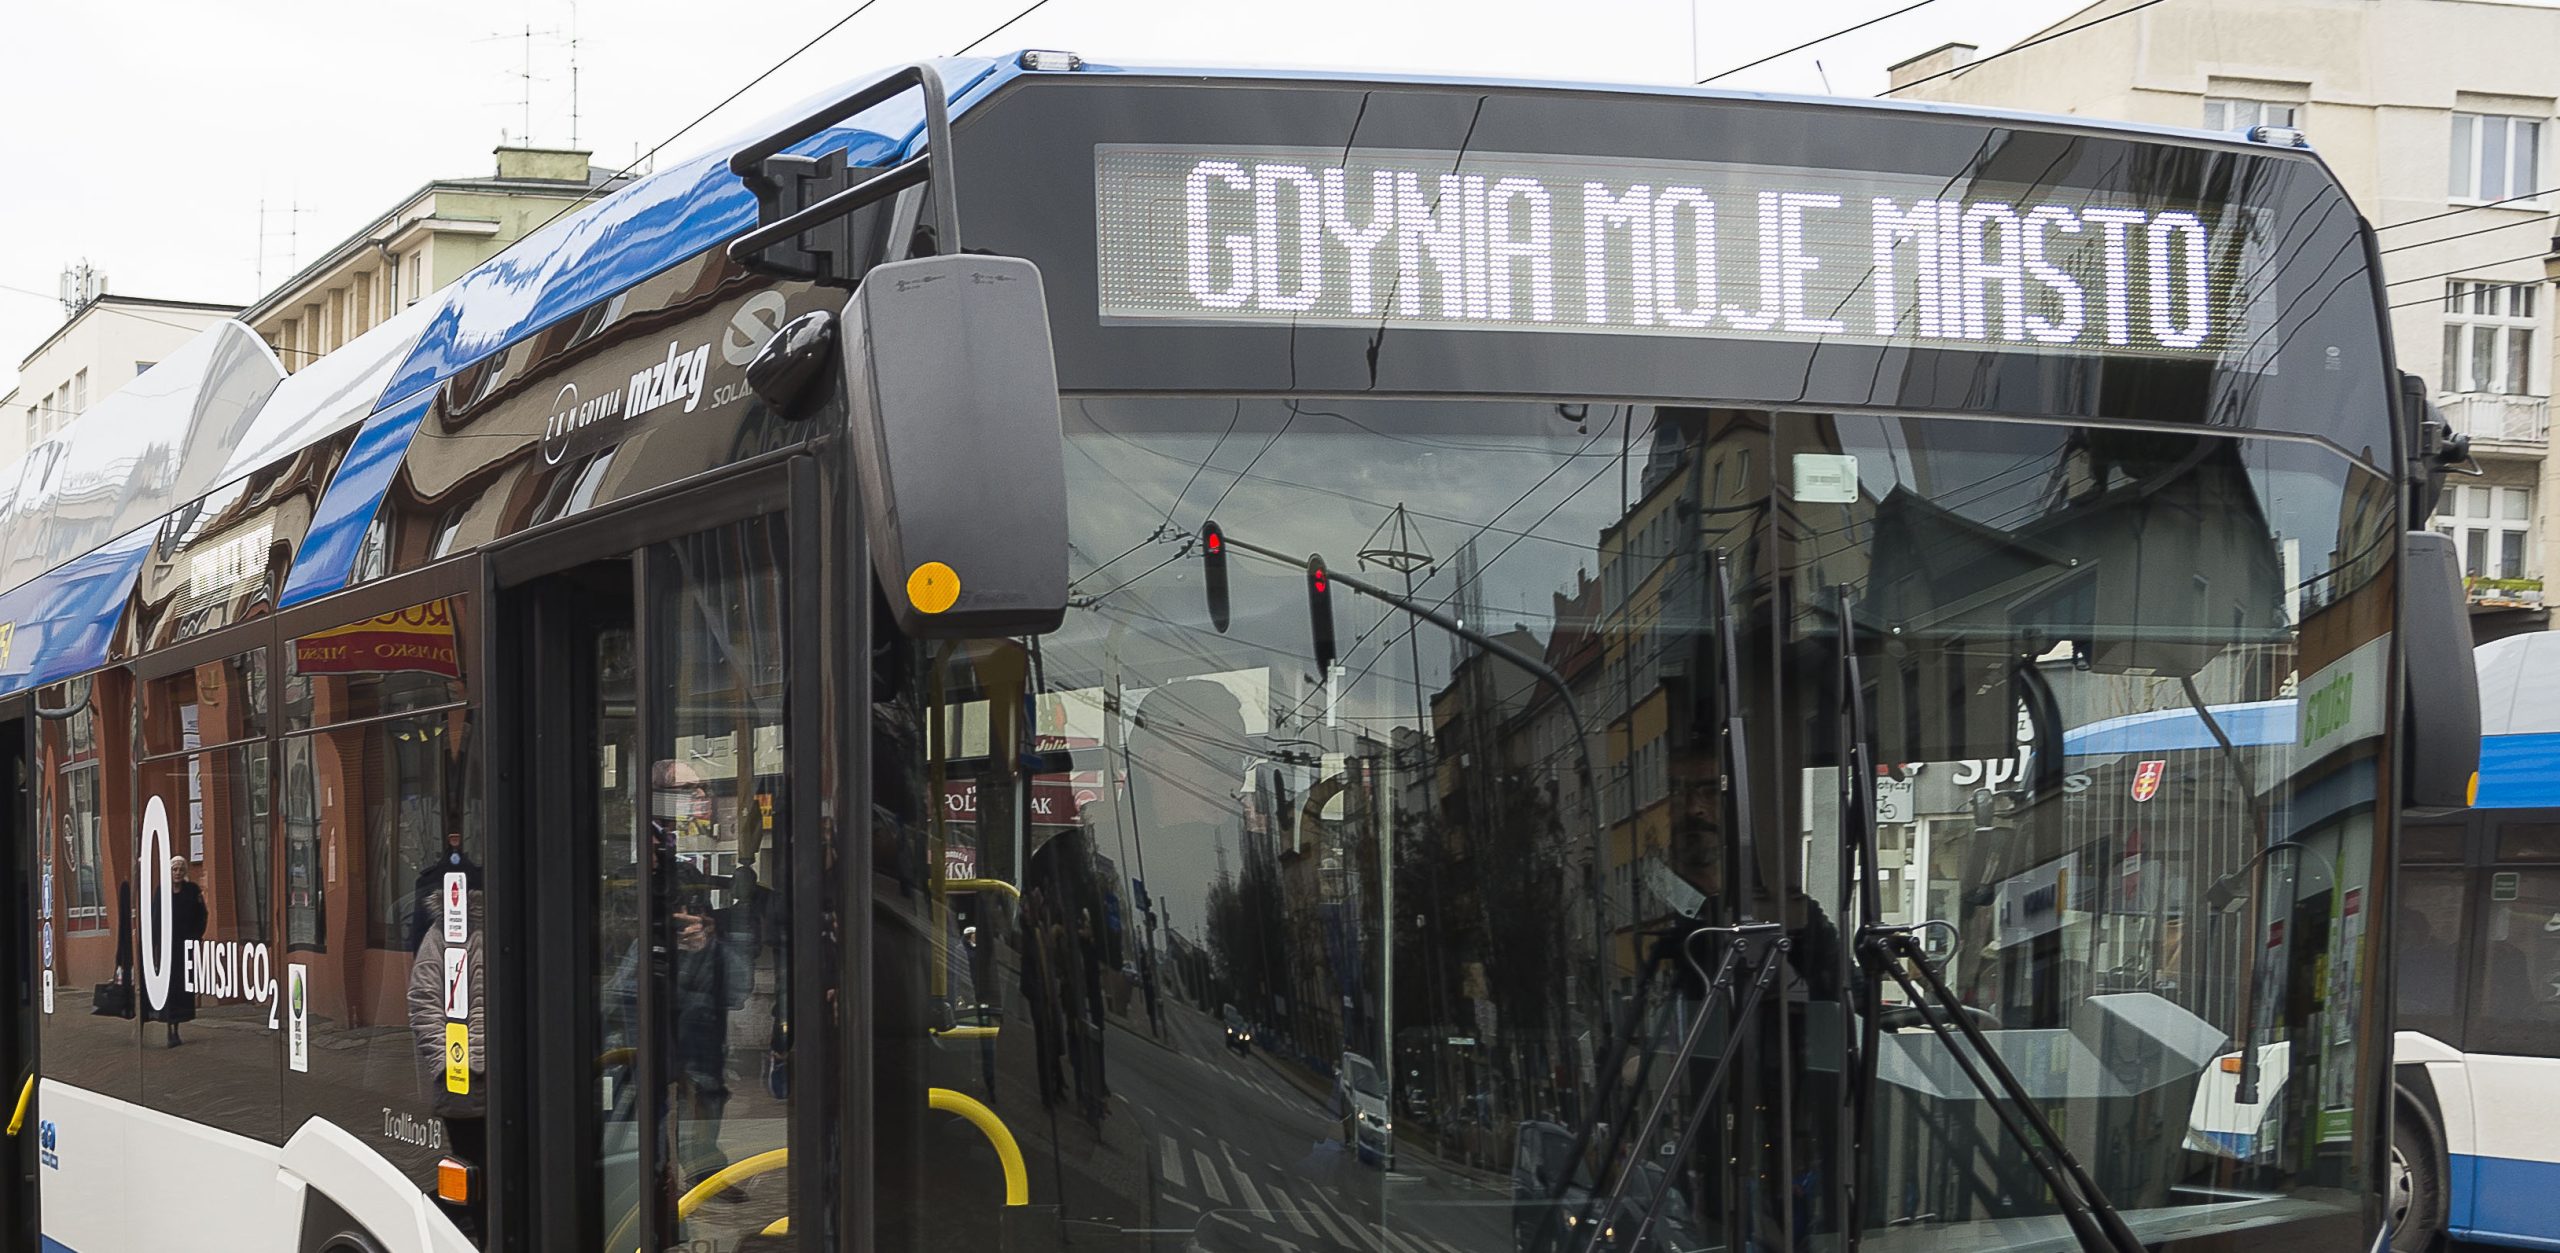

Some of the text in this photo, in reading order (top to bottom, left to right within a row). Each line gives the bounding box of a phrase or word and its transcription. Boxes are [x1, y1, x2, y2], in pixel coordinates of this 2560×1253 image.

[1186, 160, 2209, 348] GDYNIA MOJE MIASTO
[578, 388, 621, 428] GDYNIA
[623, 340, 711, 420] mzkzg
[711, 378, 753, 409] SOLA
[1031, 797, 1052, 815] AK
[1877, 780, 1912, 793] otyczy
[140, 795, 173, 1011] 0
[184, 939, 238, 999] EMISJI
[382, 1107, 442, 1149] Trollino 18
